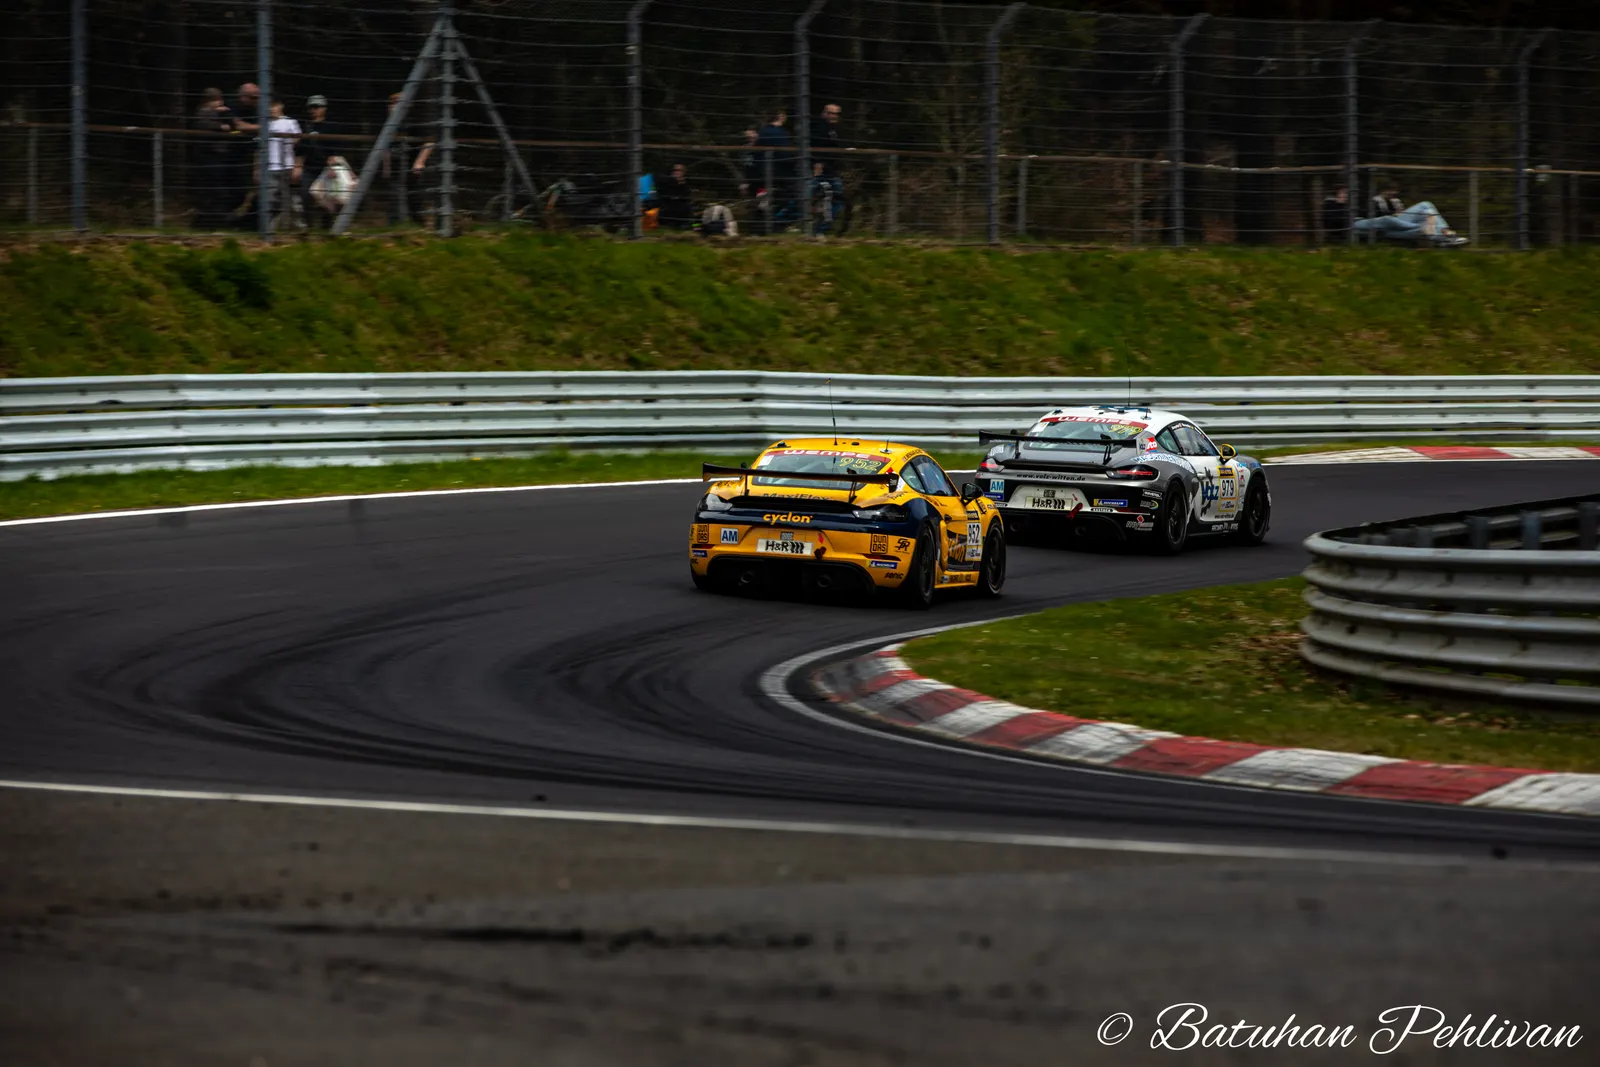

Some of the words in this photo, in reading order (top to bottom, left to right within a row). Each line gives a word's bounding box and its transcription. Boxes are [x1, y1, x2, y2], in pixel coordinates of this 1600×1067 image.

[1058, 416, 1132, 425] WEMPE
[783, 450, 870, 458] WEMPE
[839, 457, 882, 471] 952
[1016, 472, 1086, 482] www.volz-witten.de
[990, 481, 1004, 492] AM
[1221, 480, 1235, 498] 979
[1031, 498, 1053, 509] H&R
[763, 512, 812, 525] cyclon
[721, 529, 739, 542] AM
[968, 523, 981, 544] 952
[765, 540, 789, 552] H&R
